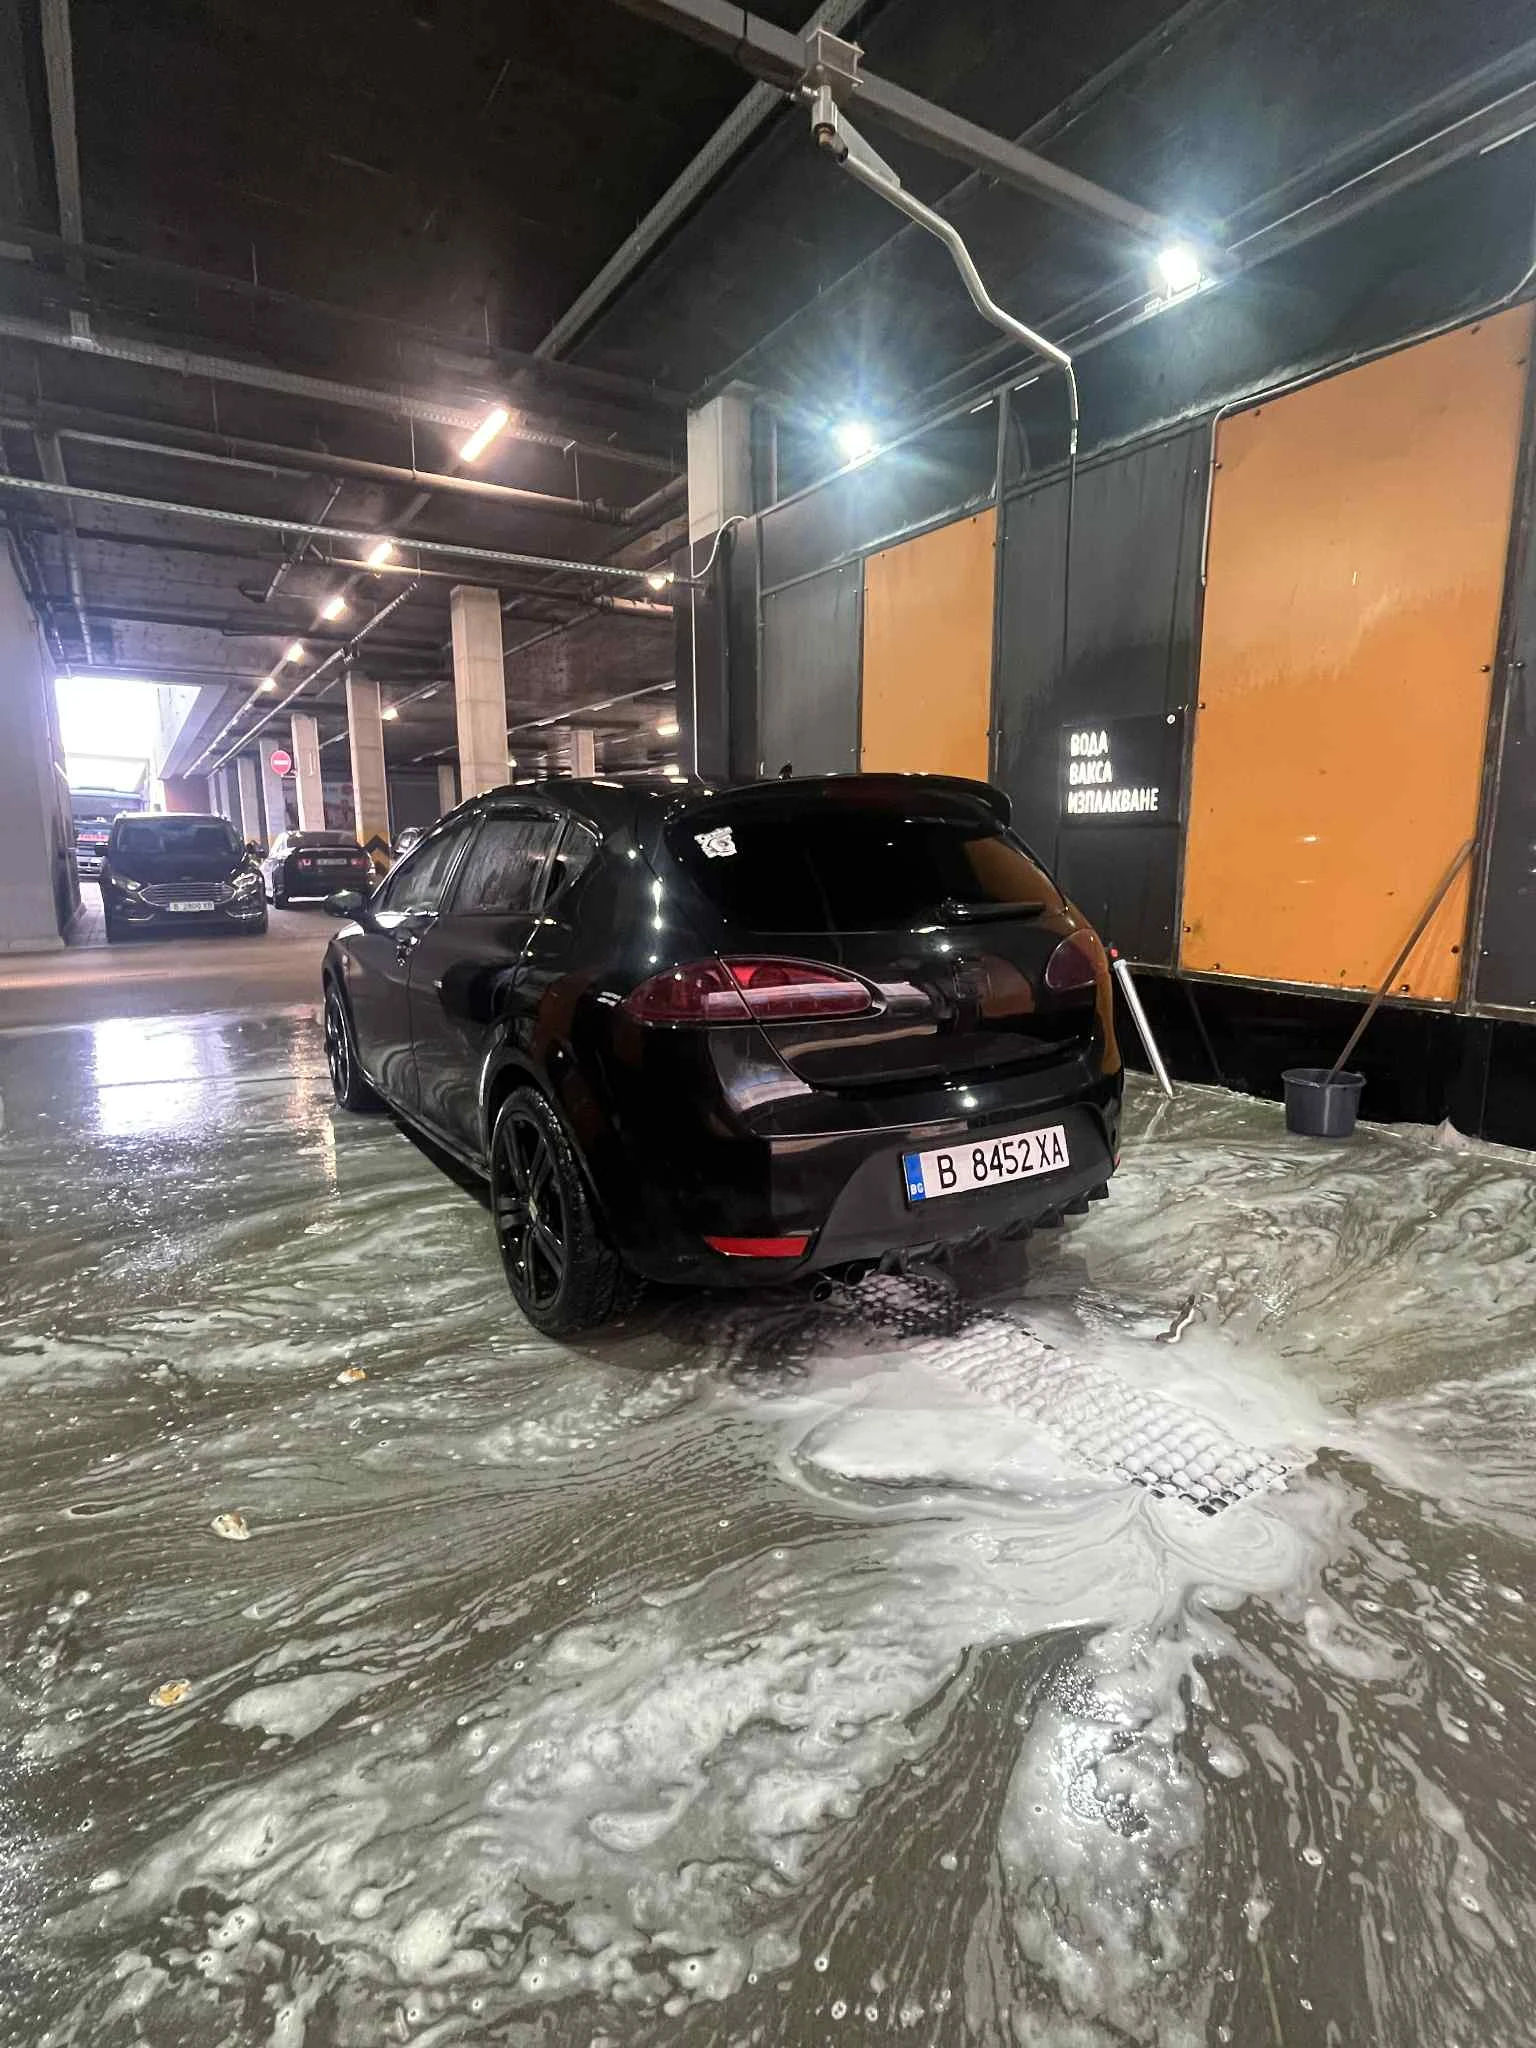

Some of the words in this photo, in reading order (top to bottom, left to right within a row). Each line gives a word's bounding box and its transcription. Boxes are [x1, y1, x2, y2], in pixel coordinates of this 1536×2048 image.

[1070, 730, 1108, 757] ВОДА
[1069, 760, 1112, 785] ВАКСА
[1067, 787, 1159, 814] ИЗПЛАКВАНЕ
[937, 1154, 957, 1189] B
[910, 1183, 924, 1195] BG
